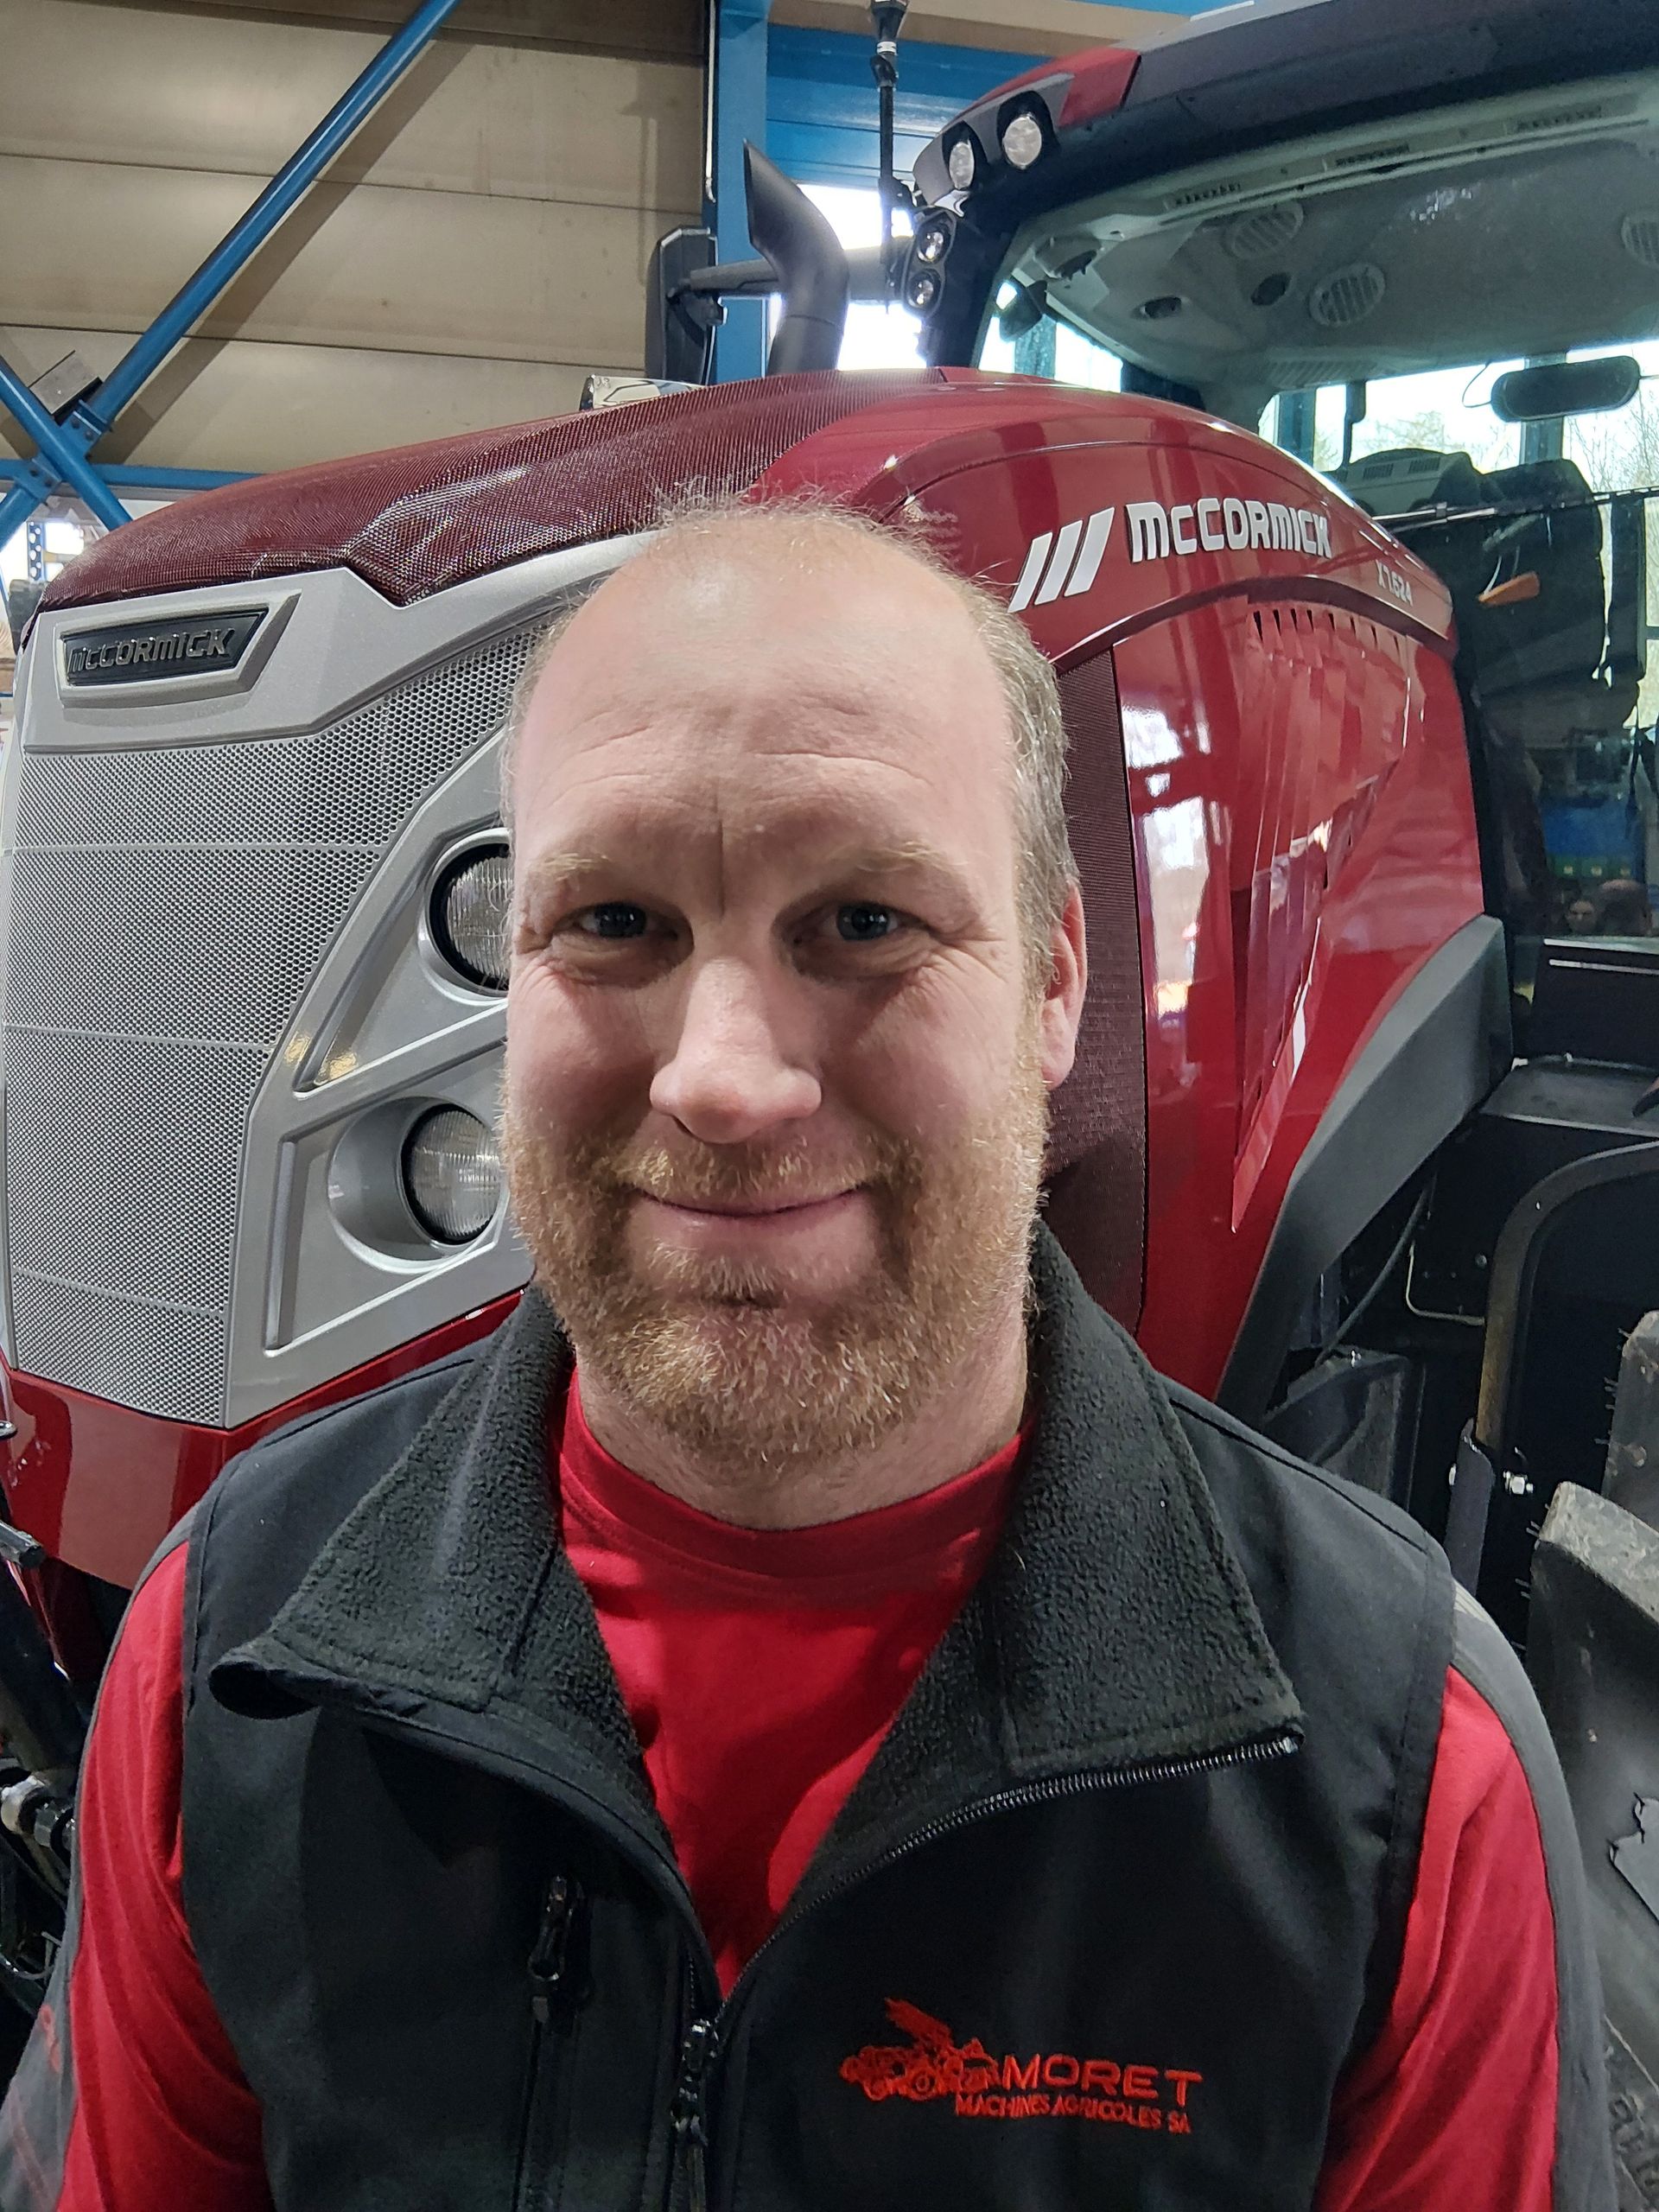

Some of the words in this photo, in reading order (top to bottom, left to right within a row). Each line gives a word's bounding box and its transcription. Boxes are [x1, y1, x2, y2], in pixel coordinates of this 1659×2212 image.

[1002, 2053, 1203, 2107] MORET
[956, 2094, 1050, 2117] MACHINES
[1052, 2095, 1161, 2129] AGRICOLES
[1168, 2112, 1191, 2133] SA
